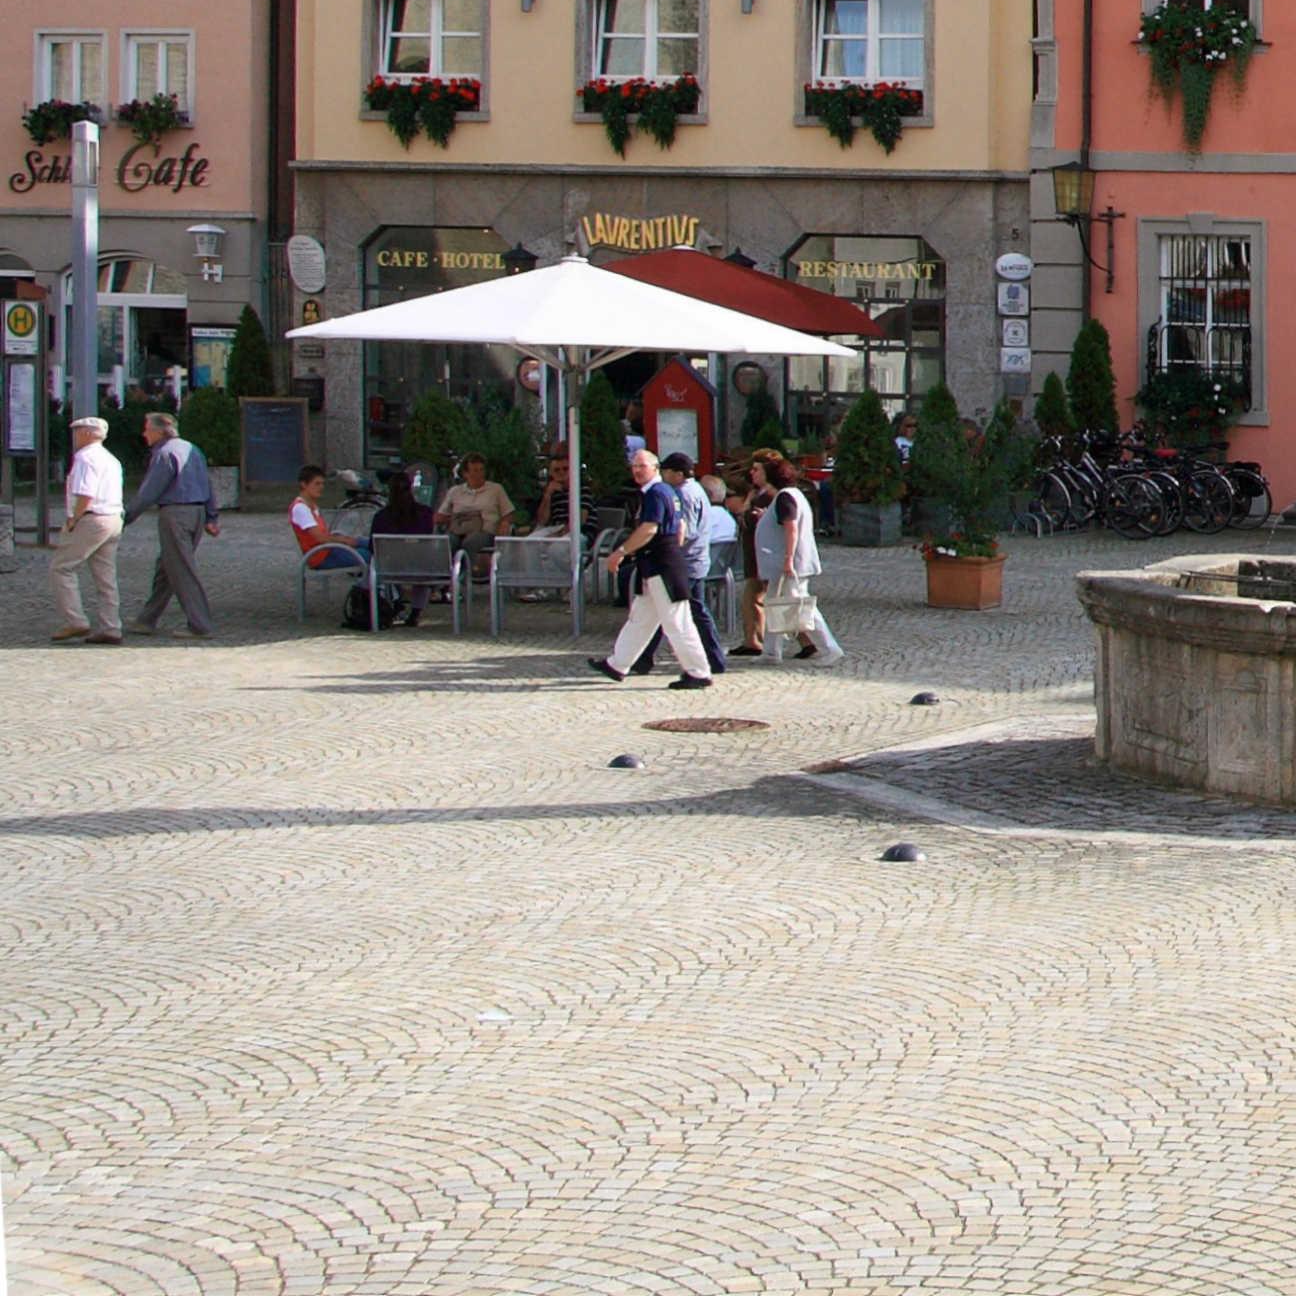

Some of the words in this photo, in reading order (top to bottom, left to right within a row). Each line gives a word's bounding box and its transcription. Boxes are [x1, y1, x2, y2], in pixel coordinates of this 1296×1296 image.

[1011, 228, 1020, 240] 5
[377, 250, 428, 267] CAFE
[440, 252, 506, 270] HOTEL
[800, 260, 936, 280] RESTAURANT
